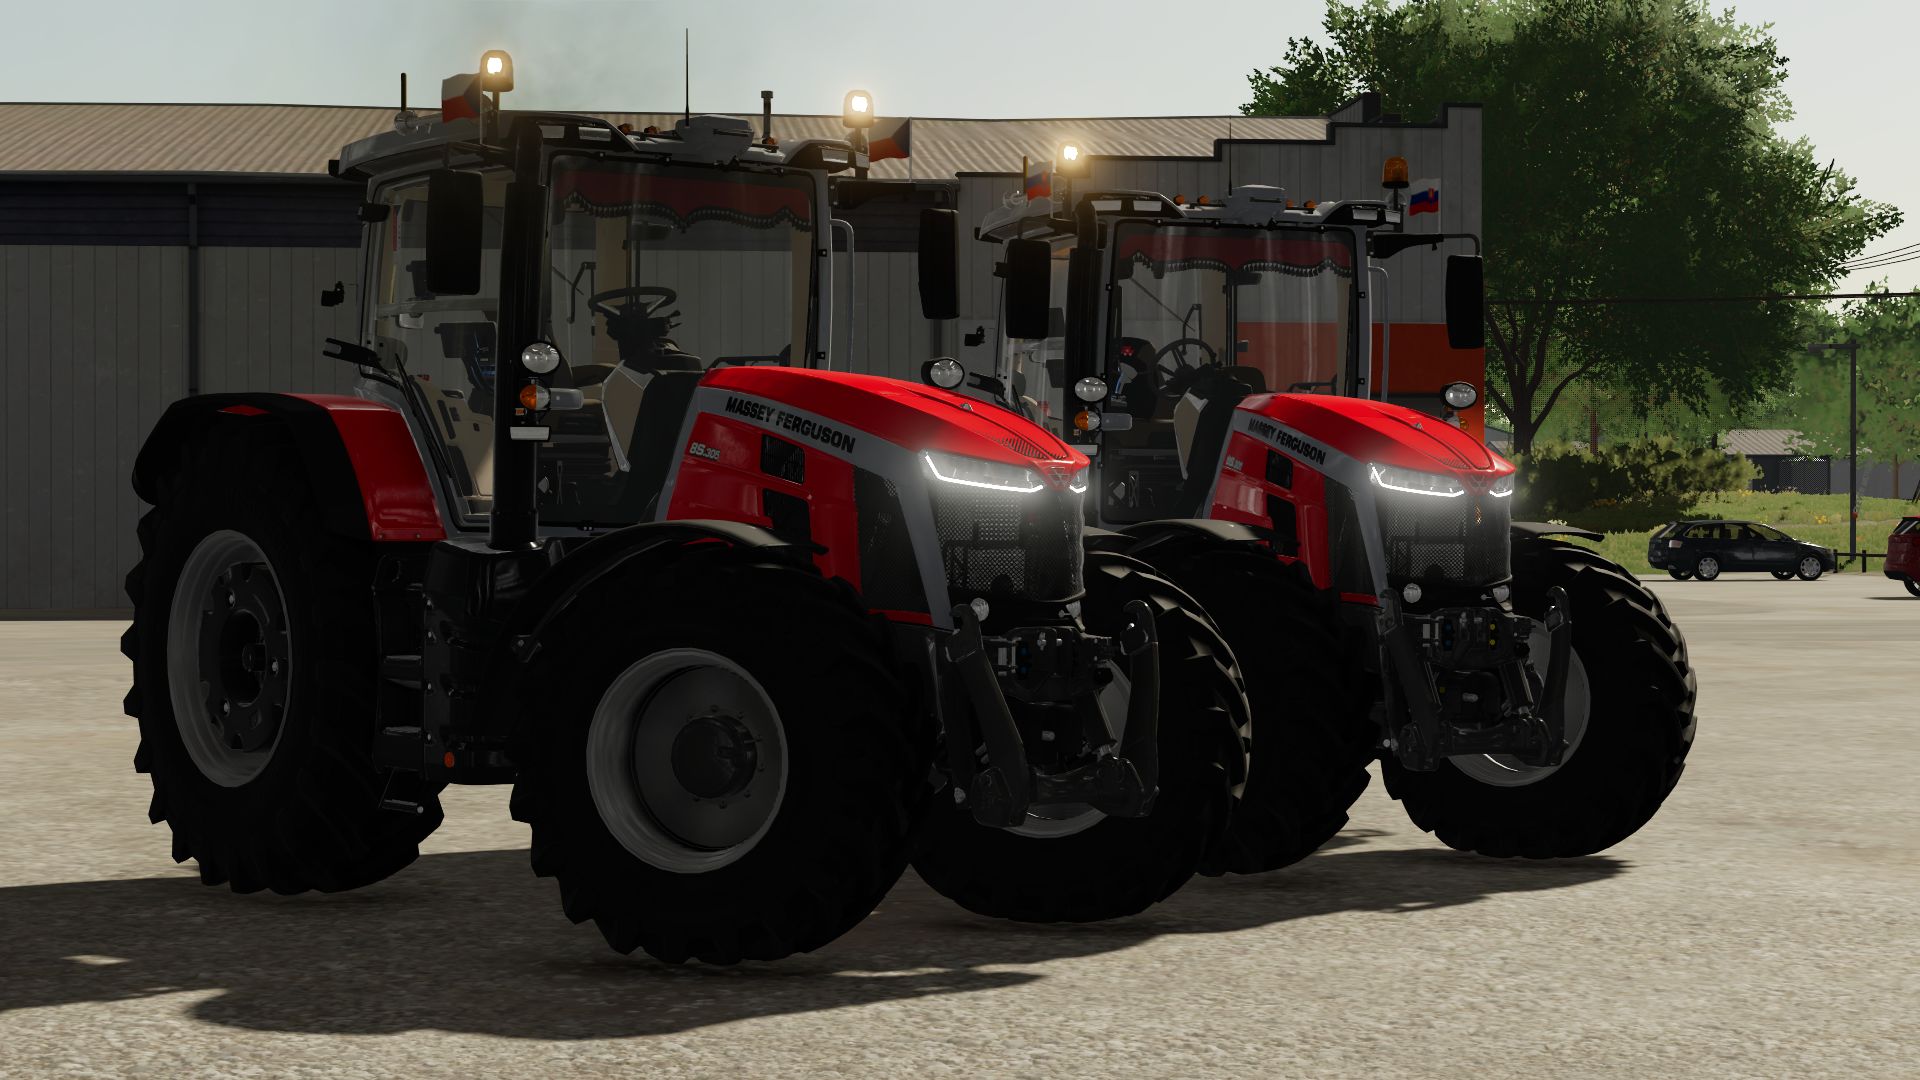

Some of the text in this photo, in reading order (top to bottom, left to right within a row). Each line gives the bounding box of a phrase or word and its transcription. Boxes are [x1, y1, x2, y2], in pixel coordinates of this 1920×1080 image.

[725, 396, 856, 453] MASSEY FERGUSON
[1276, 430, 1327, 465] FERGUSON
